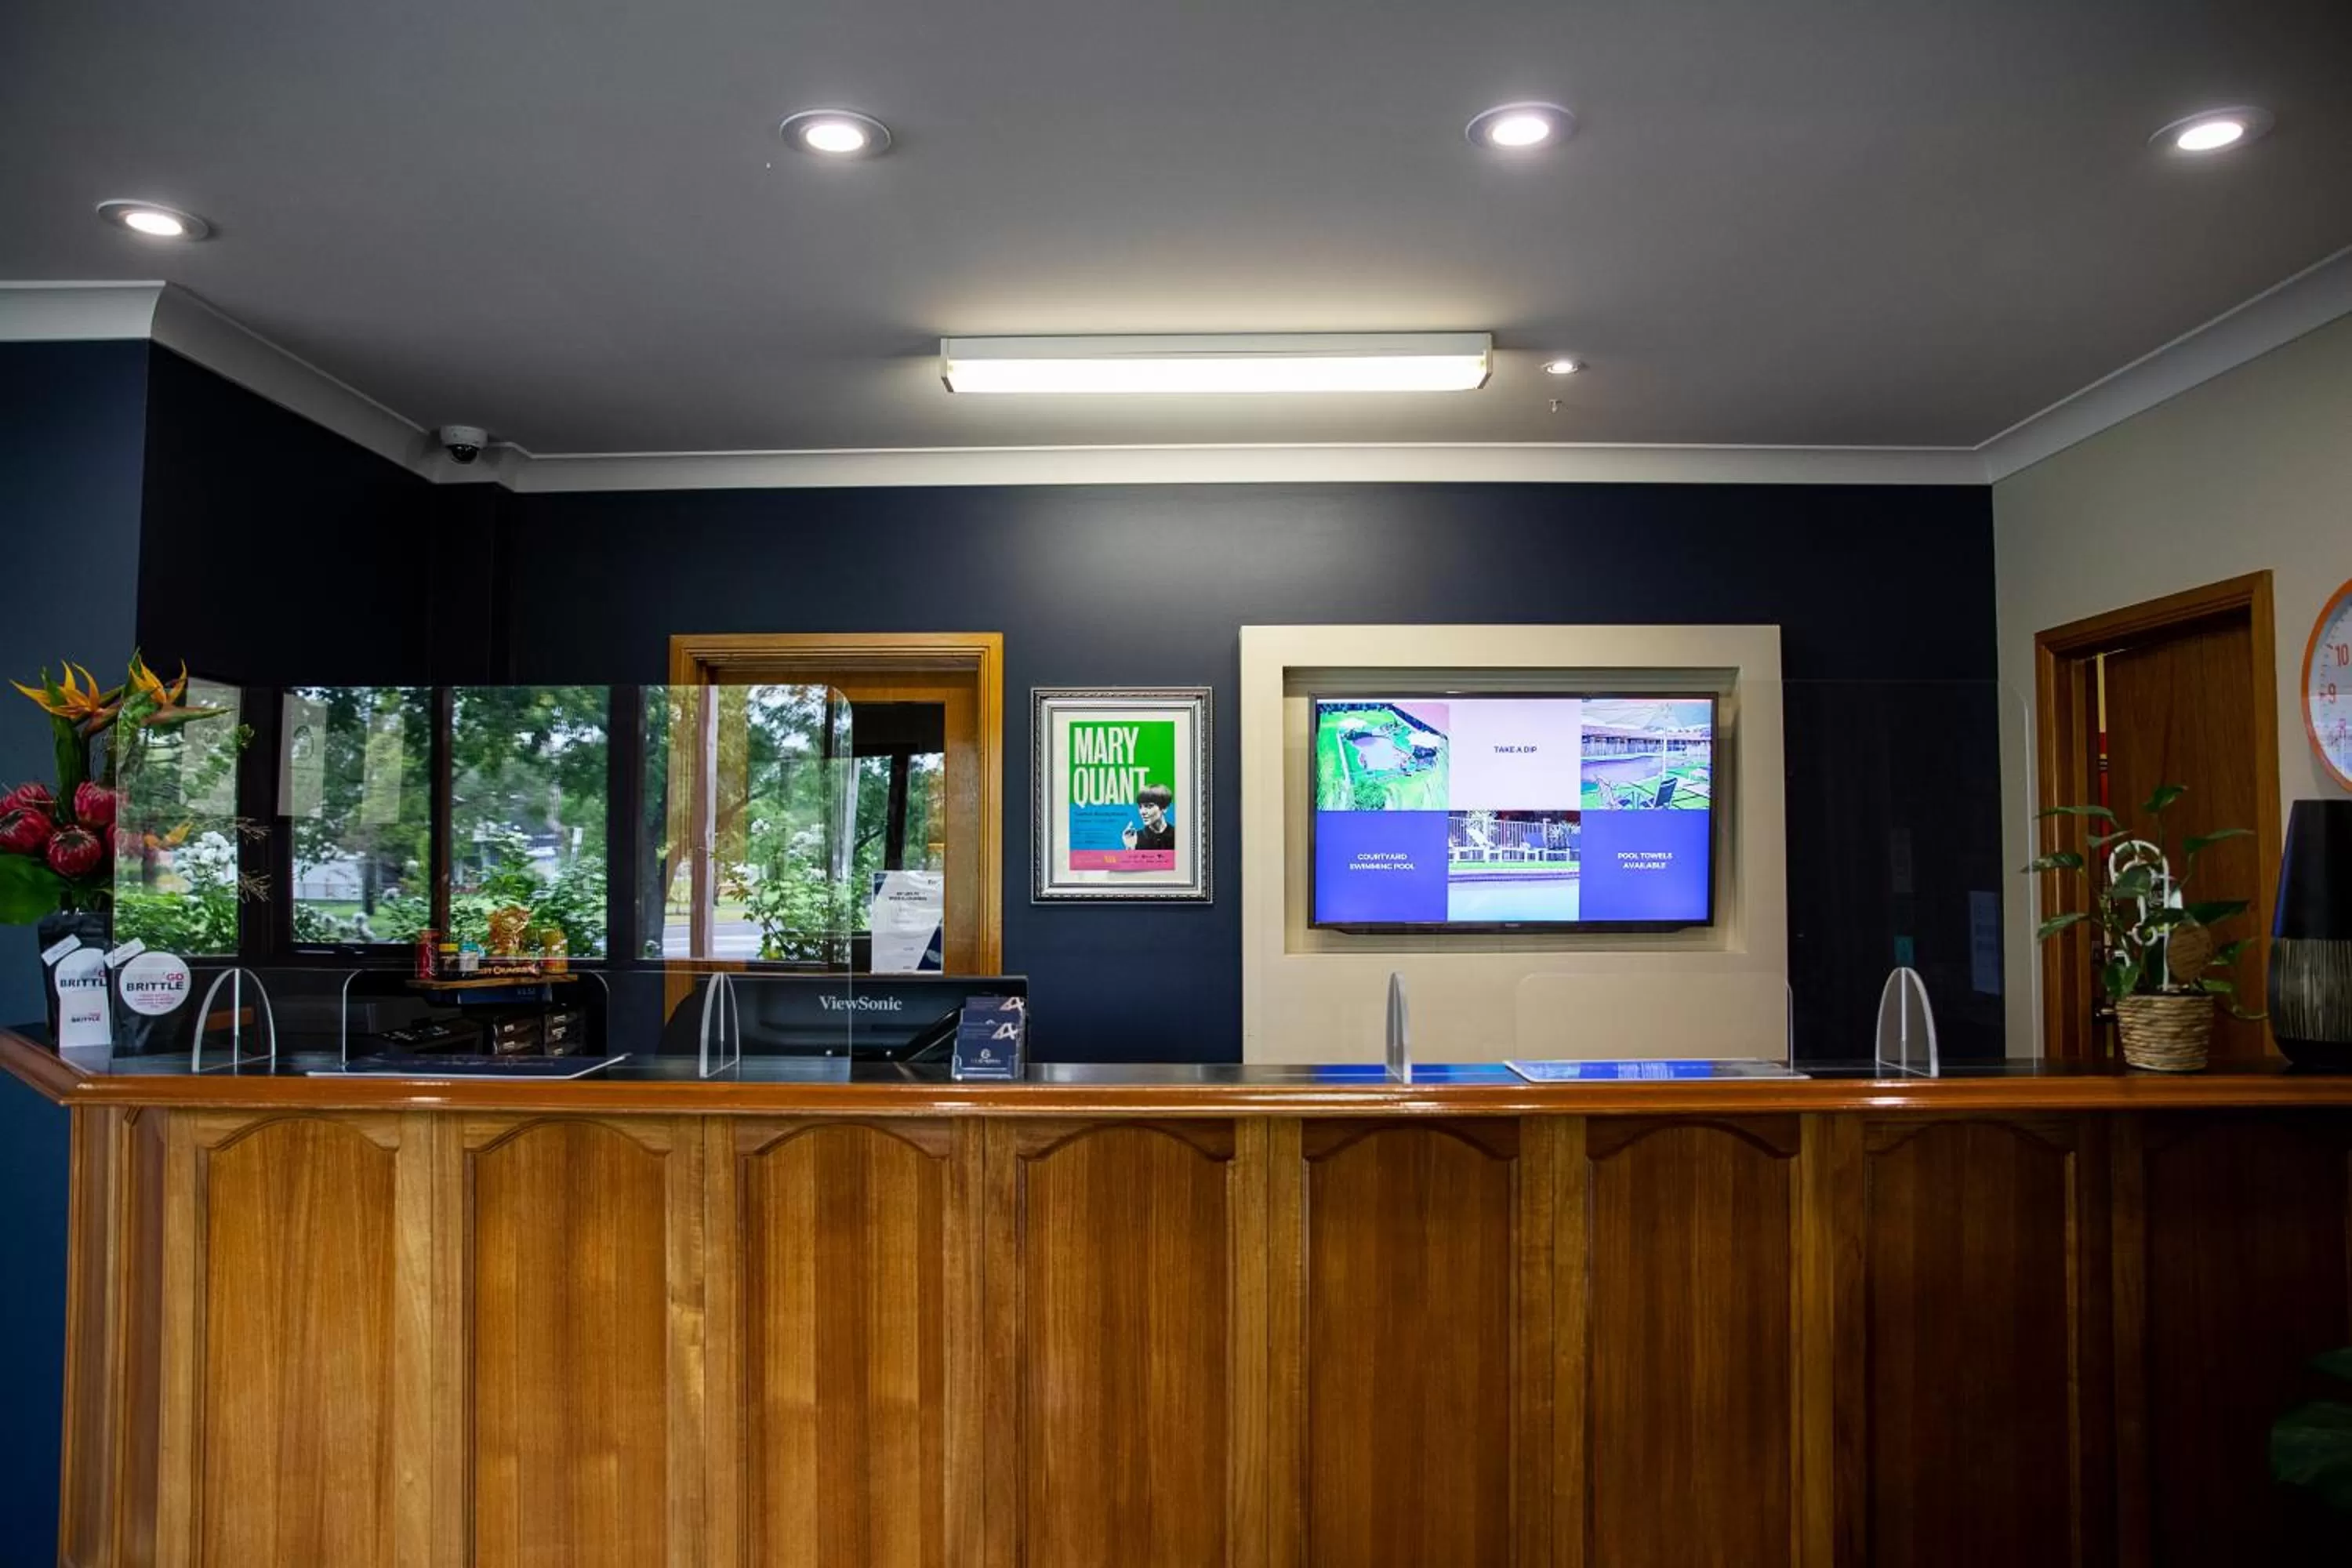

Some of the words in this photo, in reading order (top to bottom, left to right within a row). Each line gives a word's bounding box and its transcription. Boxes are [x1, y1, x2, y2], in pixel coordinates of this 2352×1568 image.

[2335, 644, 2349, 666] 10
[2327, 683, 2336, 704] 9
[1074, 727, 1139, 764] MARY
[1073, 767, 1150, 808] QUANT
[60, 978, 107, 988] BRITTL
[126, 982, 184, 992] BRITTLE
[819, 996, 902, 1011] ViewSonic
